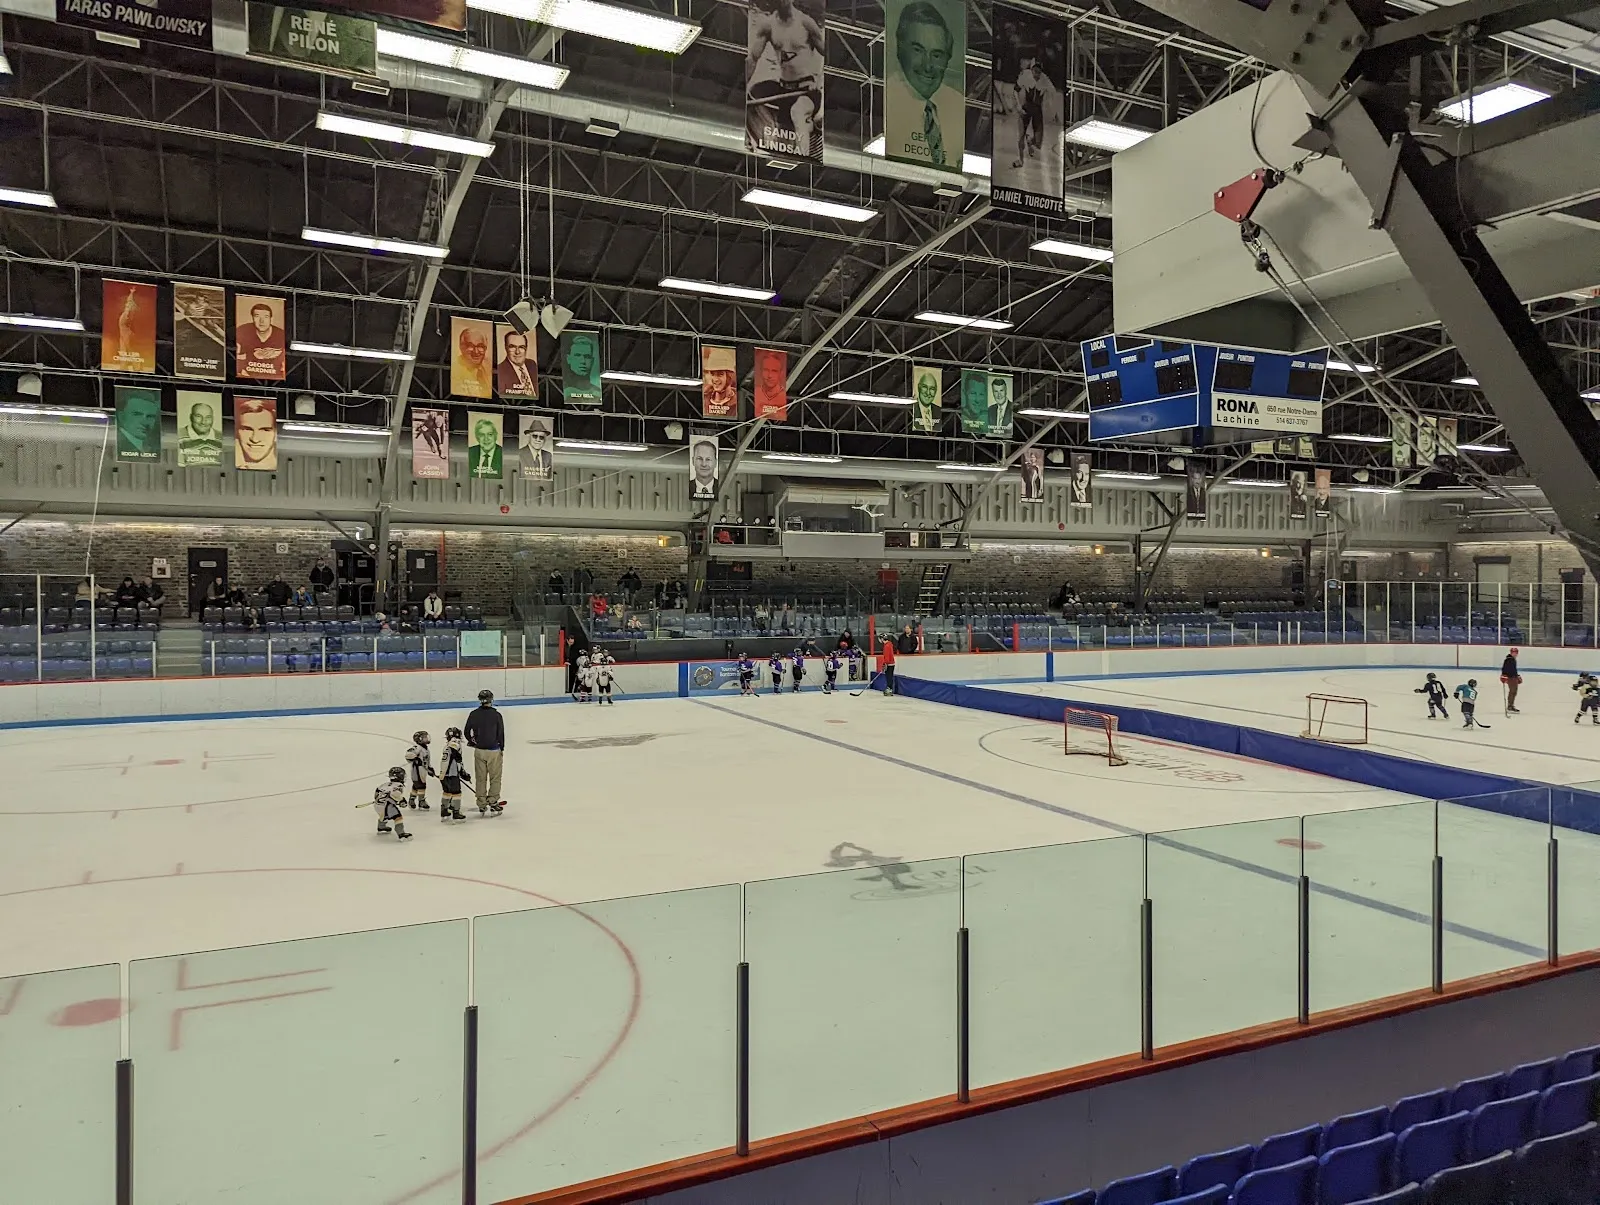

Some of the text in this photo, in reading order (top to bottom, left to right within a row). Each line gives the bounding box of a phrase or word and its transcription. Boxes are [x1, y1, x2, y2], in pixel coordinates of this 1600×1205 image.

[65, 0, 207, 36] TARAS PAWLOWSKY
[291, 14, 337, 37] RENÉ
[288, 32, 340, 55] PILON
[763, 126, 803, 142] SANDY
[992, 189, 1064, 212] DANIEL TURCOTTE
[1090, 340, 1106, 351] LOCAL
[246, 366, 277, 374] GARDNER
[248, 361, 274, 369] GEORGE
[1217, 398, 1259, 414] RONA
[1287, 406, 1317, 416] Notre-Dame
[1216, 413, 1260, 425] Lachine
